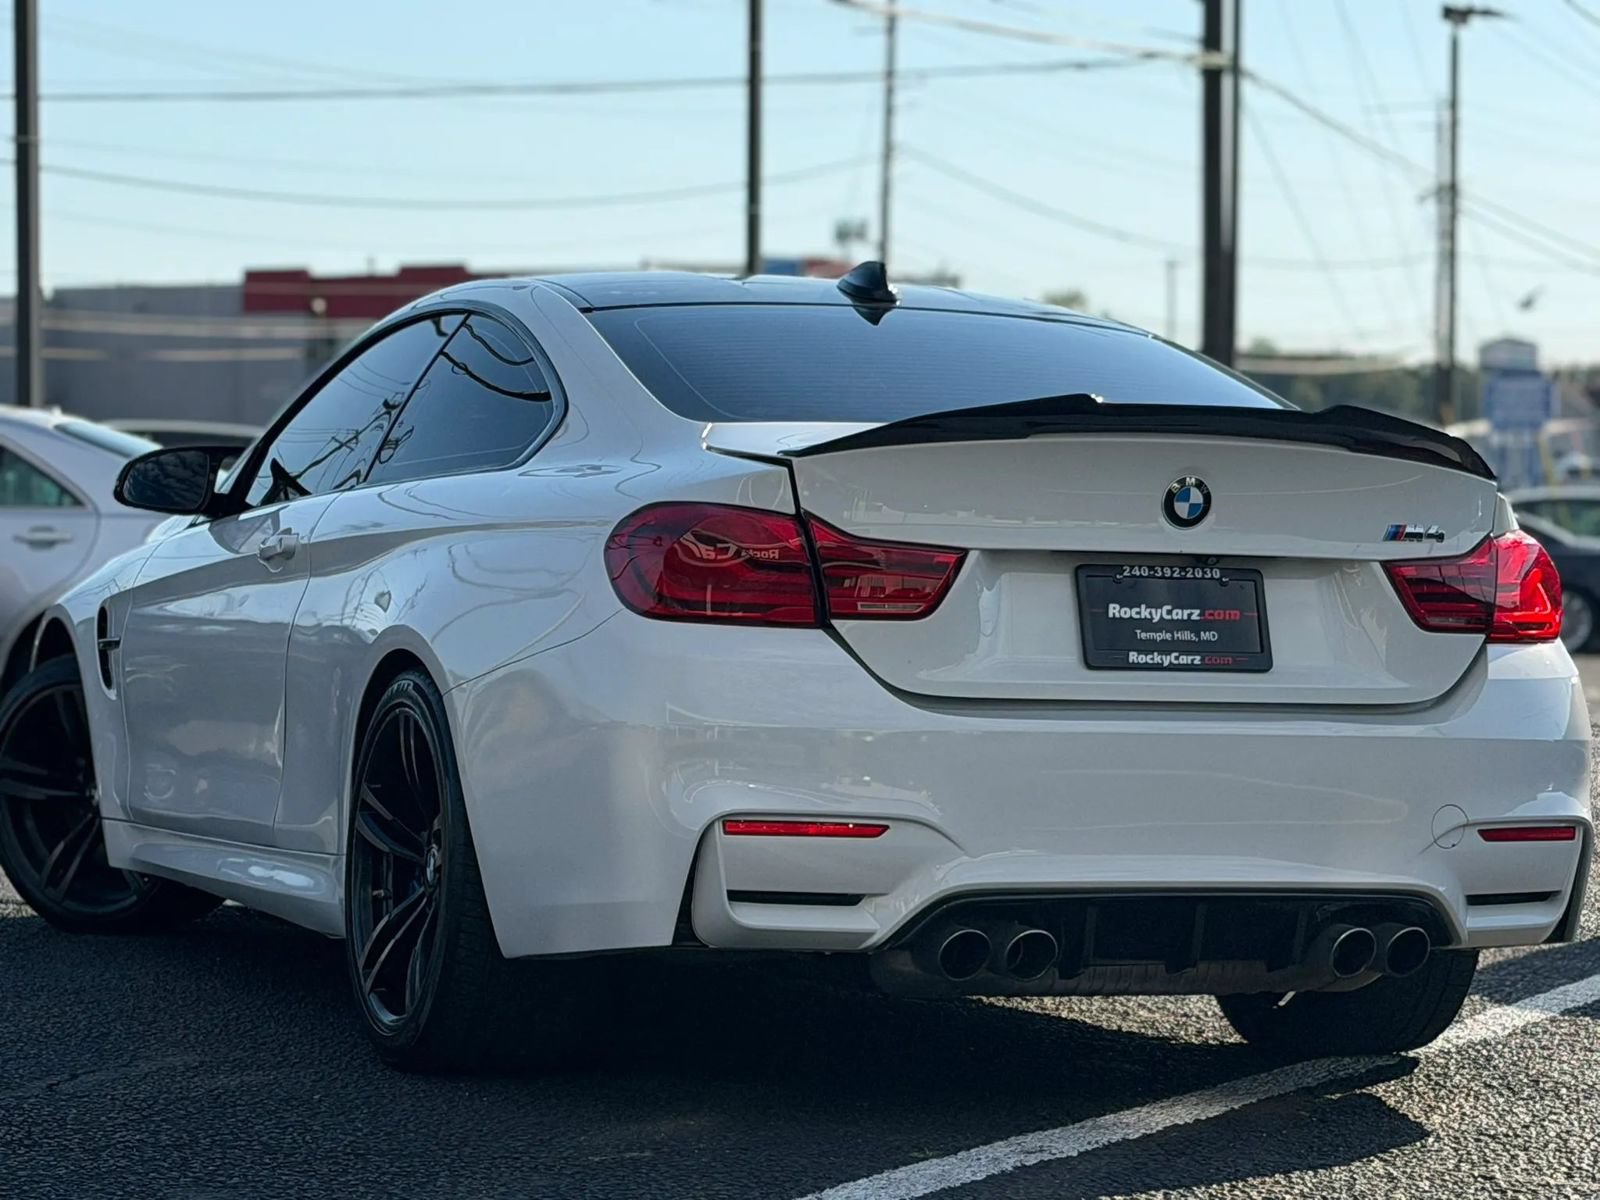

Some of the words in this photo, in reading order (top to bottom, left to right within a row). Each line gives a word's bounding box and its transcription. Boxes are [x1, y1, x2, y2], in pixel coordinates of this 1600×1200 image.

[1170, 476, 1209, 494] BMW
[1402, 523, 1446, 543] M4
[1122, 565, 1221, 579] 240-392-2030
[1108, 603, 1241, 623] RockyCarz.com
[1135, 629, 1172, 642] Temple
[1174, 630, 1199, 642] Hills,
[1200, 631, 1219, 642] MD
[1128, 651, 1233, 667] RockyCarzcom
